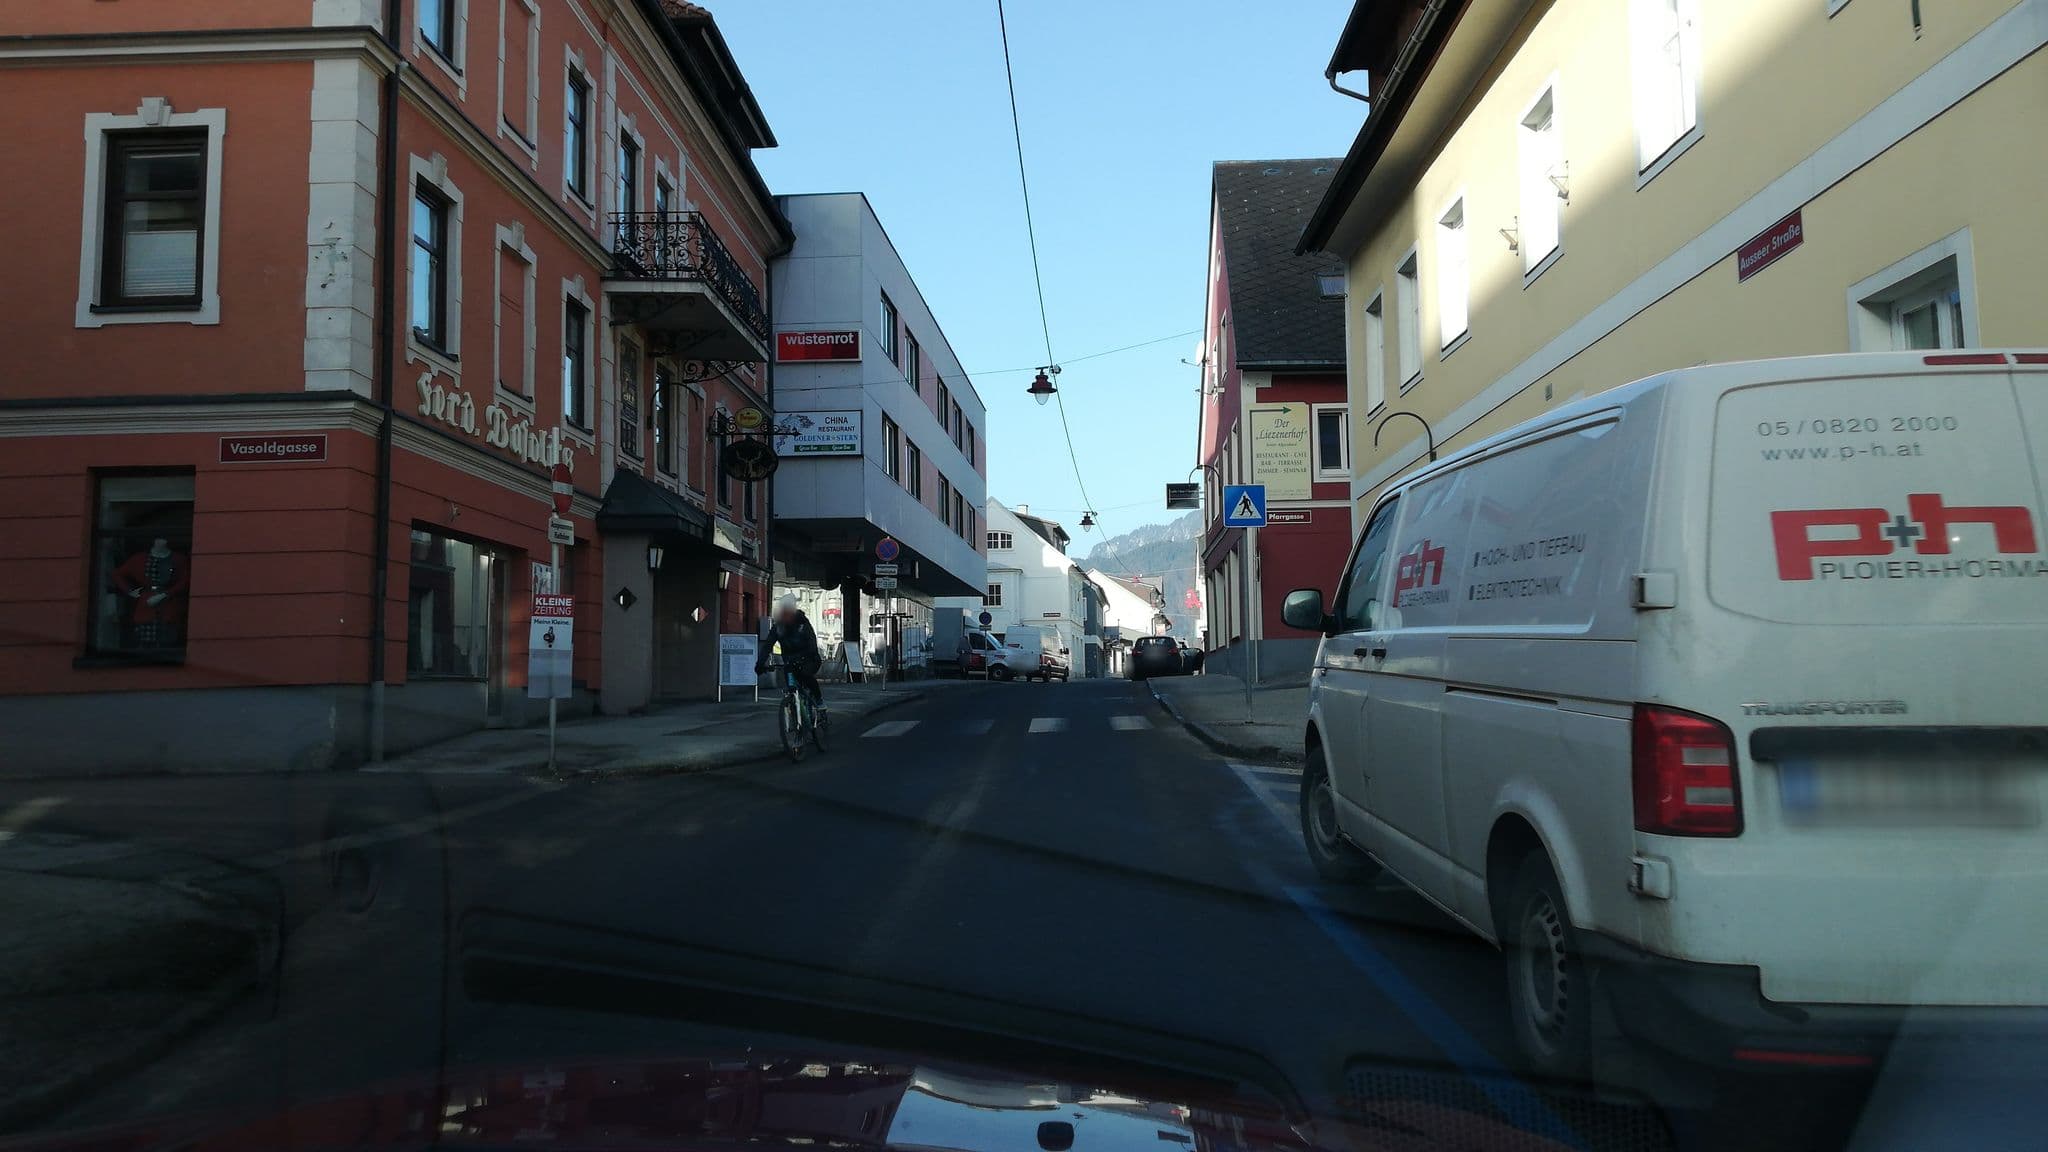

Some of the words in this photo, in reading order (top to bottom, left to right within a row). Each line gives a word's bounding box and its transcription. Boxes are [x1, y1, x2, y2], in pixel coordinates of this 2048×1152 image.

[1740, 244, 1770, 271] Ausseer
[1772, 224, 1800, 250] Straße
[786, 332, 855, 345] wüstenrot
[824, 416, 848, 424] CHINA
[1274, 418, 1290, 428] Der
[1892, 416, 1958, 432] 2000
[230, 441, 317, 456] Vasoldgasse
[1761, 441, 1925, 462] www.p-h.at
[1269, 513, 1304, 521] Pfarrgasse
[1512, 542, 1534, 562] UND
[1538, 534, 1586, 559] TIEFBAU
[1475, 575, 1562, 600] ELEKTROTECHNIK
[535, 597, 573, 606] KLEINE
[534, 606, 572, 615] ZEITUNG
[1740, 700, 1909, 715] TRANSPORTER
